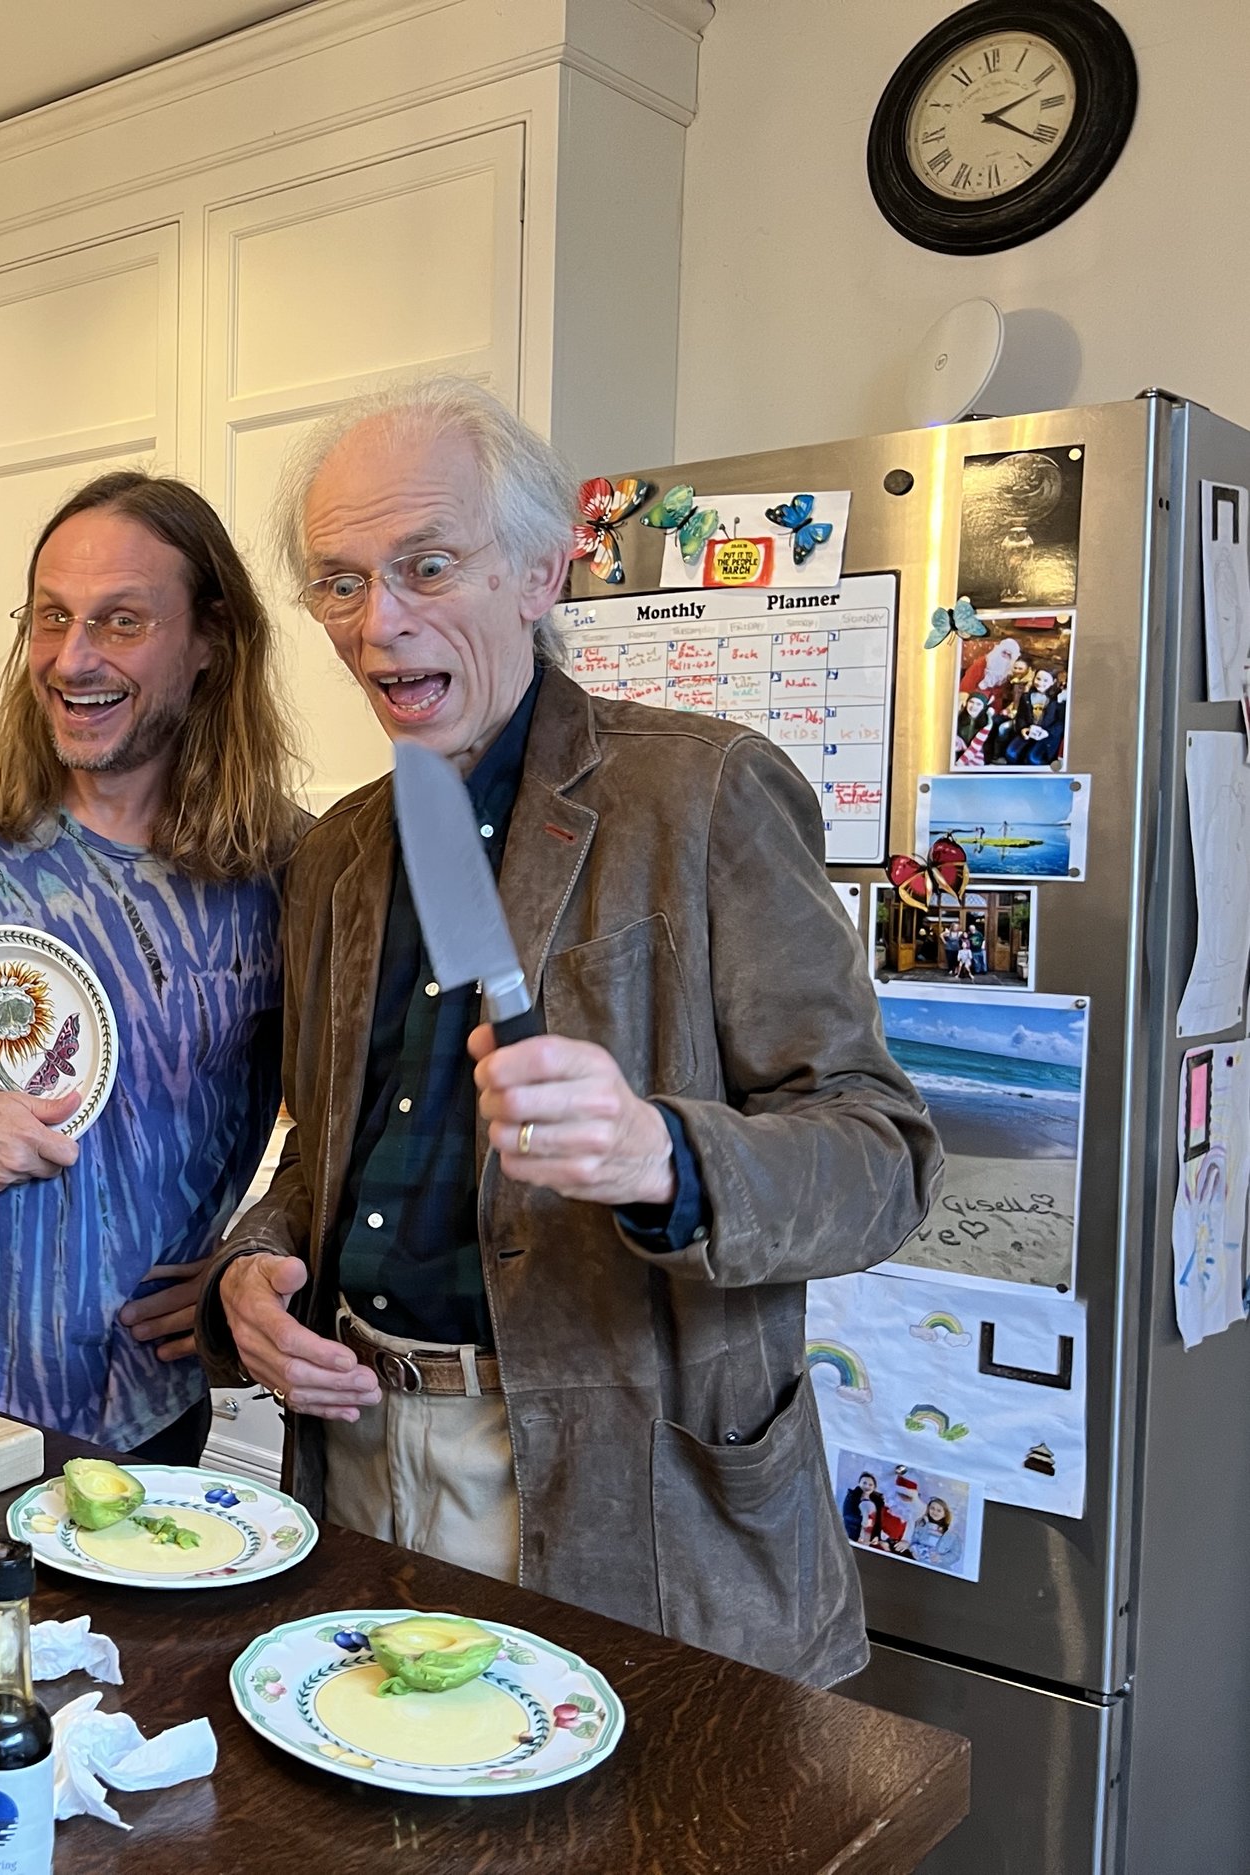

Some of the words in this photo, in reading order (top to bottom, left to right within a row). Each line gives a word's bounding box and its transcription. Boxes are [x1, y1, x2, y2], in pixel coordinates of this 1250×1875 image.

[723, 551, 736, 559] PUT
[717, 558, 729, 566] THE
[731, 557, 759, 567] PEOPLE
[722, 565, 751, 575] MARCH
[637, 602, 706, 621] Monthly
[767, 593, 840, 610] Planner
